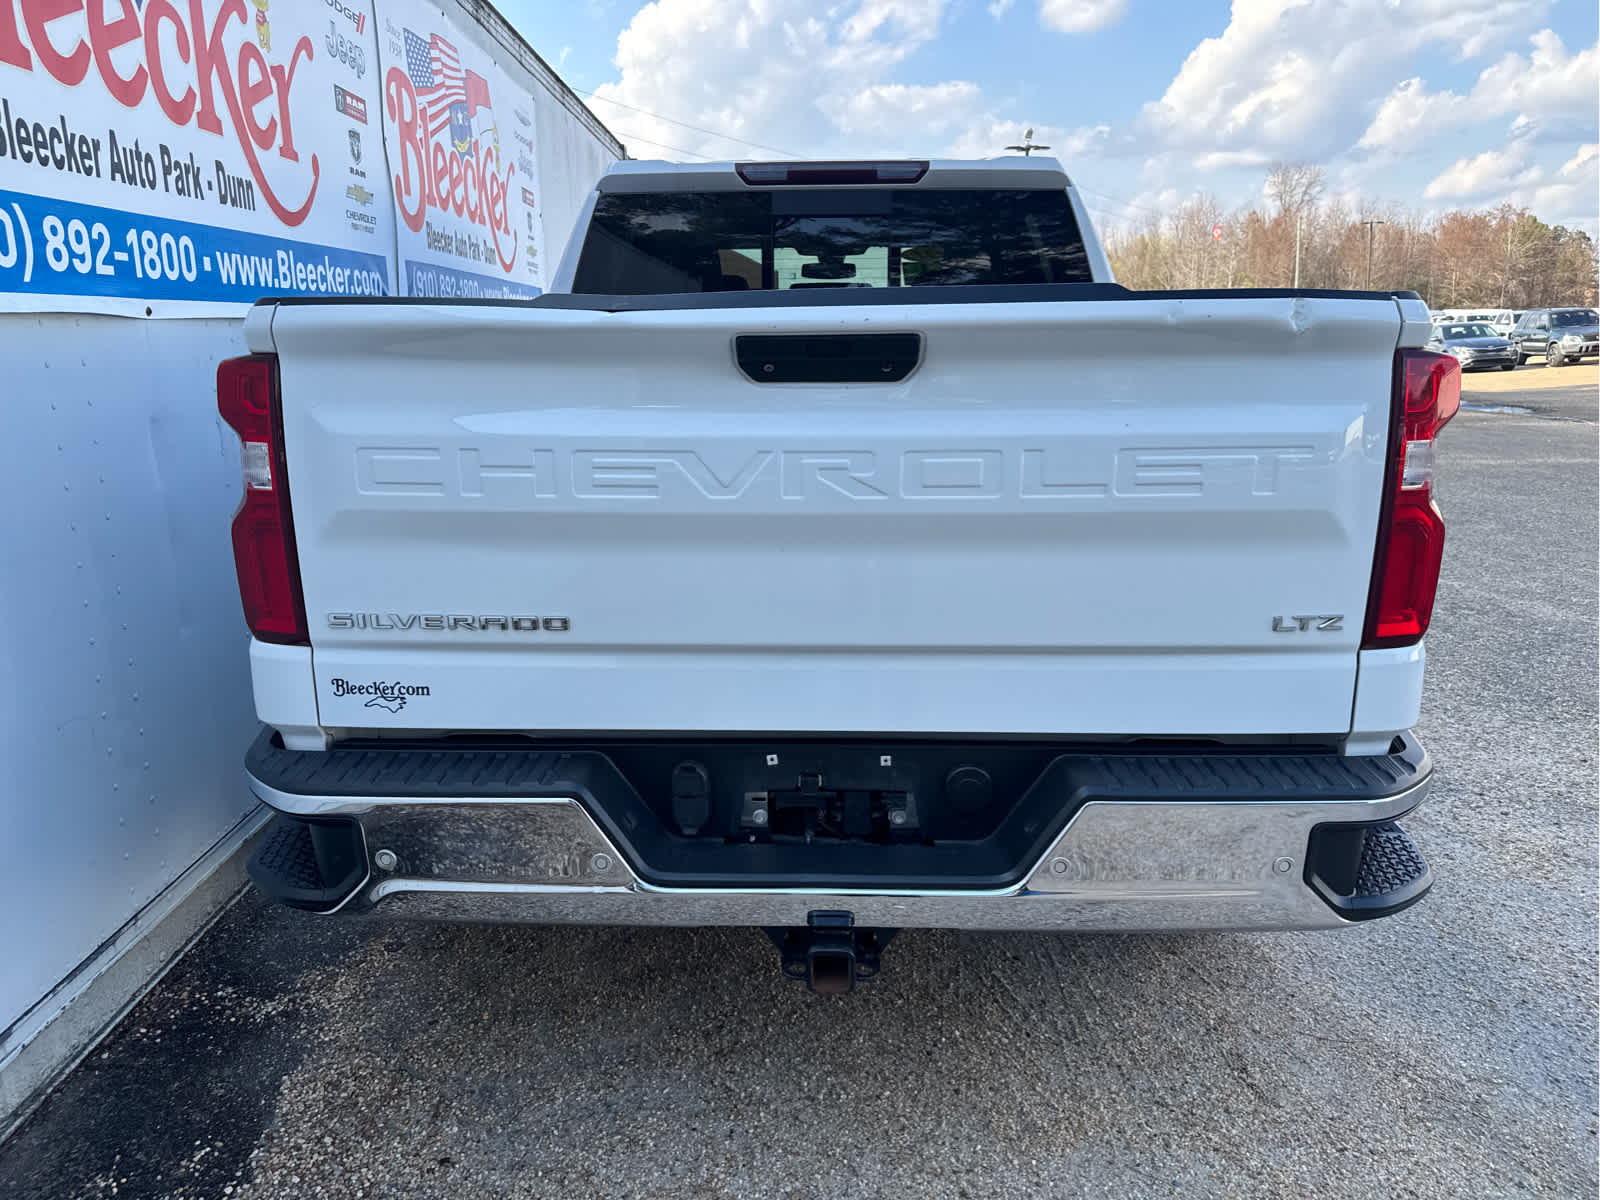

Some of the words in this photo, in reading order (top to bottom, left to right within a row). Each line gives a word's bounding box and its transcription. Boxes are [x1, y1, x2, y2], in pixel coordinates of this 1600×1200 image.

[325, 19, 366, 79] Jeep
[109, 128, 157, 190] Auto
[159, 143, 205, 201] Park
[215, 159, 256, 211] Dunn
[386, 66, 518, 273] Bleecker
[42, 214, 198, 283] 892-1800
[215, 249, 384, 297] www.Bleecker.com
[355, 446, 1314, 500] CHEVROLET
[327, 612, 571, 632] SILVERADO
[1271, 614, 1344, 633] LTZ
